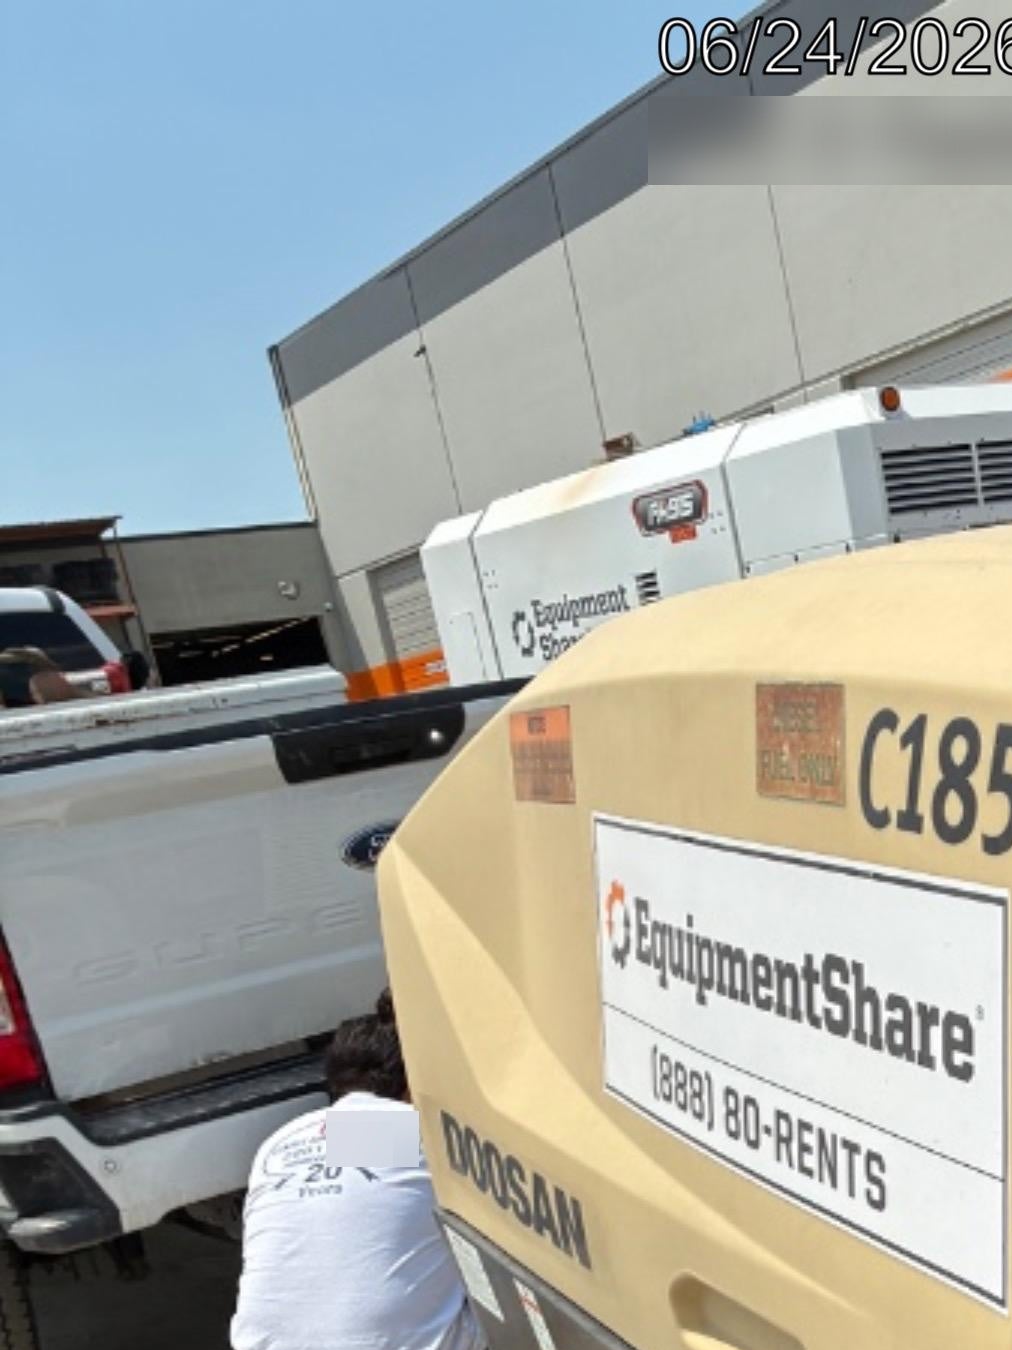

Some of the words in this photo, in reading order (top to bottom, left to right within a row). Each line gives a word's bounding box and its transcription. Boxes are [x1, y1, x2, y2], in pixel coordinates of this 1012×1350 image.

[530, 583, 631, 631] Equipment
[635, 896, 975, 1084] EquipmentShare
[304, 1162, 343, 1183] 20
[440, 1109, 593, 1271] DOOSAN
[650, 1044, 715, 1132] (888)
[724, 1085, 887, 1214] 80-RENTS
